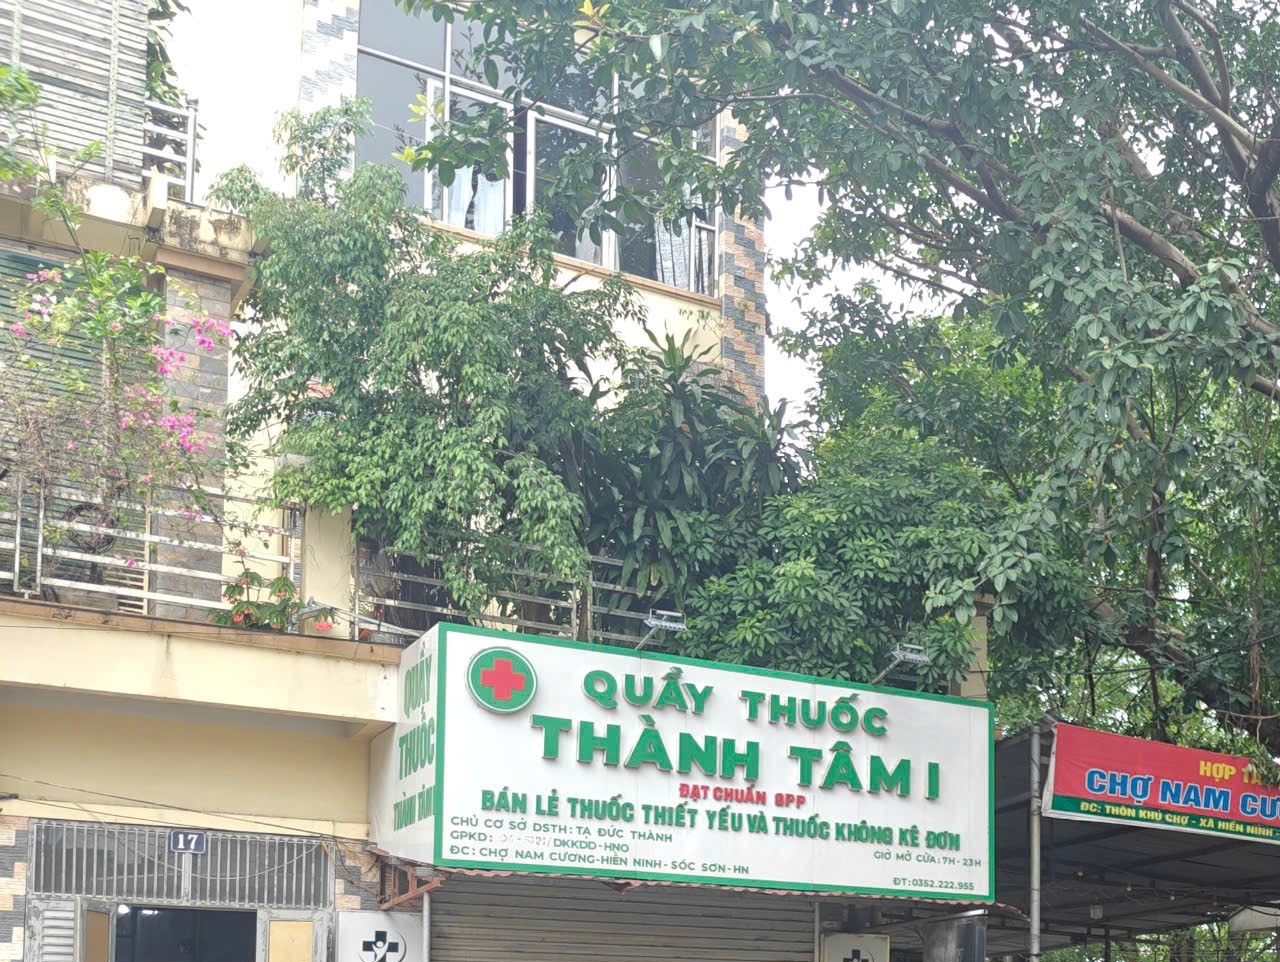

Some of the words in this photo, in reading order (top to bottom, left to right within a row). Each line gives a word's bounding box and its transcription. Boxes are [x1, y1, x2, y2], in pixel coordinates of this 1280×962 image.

[581, 666, 715, 714] QUẦY
[738, 693, 889, 737] THUỐC
[398, 706, 435, 781] THUỐC
[530, 714, 760, 782] THÀNH
[1199, 760, 1237, 782] HỢP
[679, 782, 710, 802] ĐẠT
[774, 792, 807, 809] GPP
[1085, 768, 1154, 806] CHỢ
[1159, 779, 1231, 813] NAM
[450, 814, 479, 827] CHỦ
[483, 818, 504, 829] CƠ
[508, 817, 528, 831] SỞ
[597, 825, 624, 838] ĐỨC
[630, 828, 673, 843] THÀNH
[480, 785, 528, 814] BÁN
[535, 788, 560, 817] LẺ
[567, 793, 635, 822] THUỐC
[642, 801, 698, 828] THIẾT
[705, 804, 744, 832] YẾU
[746, 810, 769, 835] VÀ
[772, 813, 831, 840] THUỐC
[835, 819, 894, 846] KHÔNG
[898, 824, 920, 847] KÊ
[925, 830, 961, 852] ĐƠN
[1080, 801, 1102, 813] ĐC:
[1165, 813, 1190, 827] CHỢ
[1246, 825, 1274, 837] NINH
[177, 833, 199, 850] 17
[873, 848, 892, 861] GIỜ
[895, 850, 912, 862] MỞ
[479, 846, 509, 862] CHỢ
[515, 850, 544, 861] NAM
[632, 858, 662, 869] NINH
[671, 859, 696, 871] SÓC
